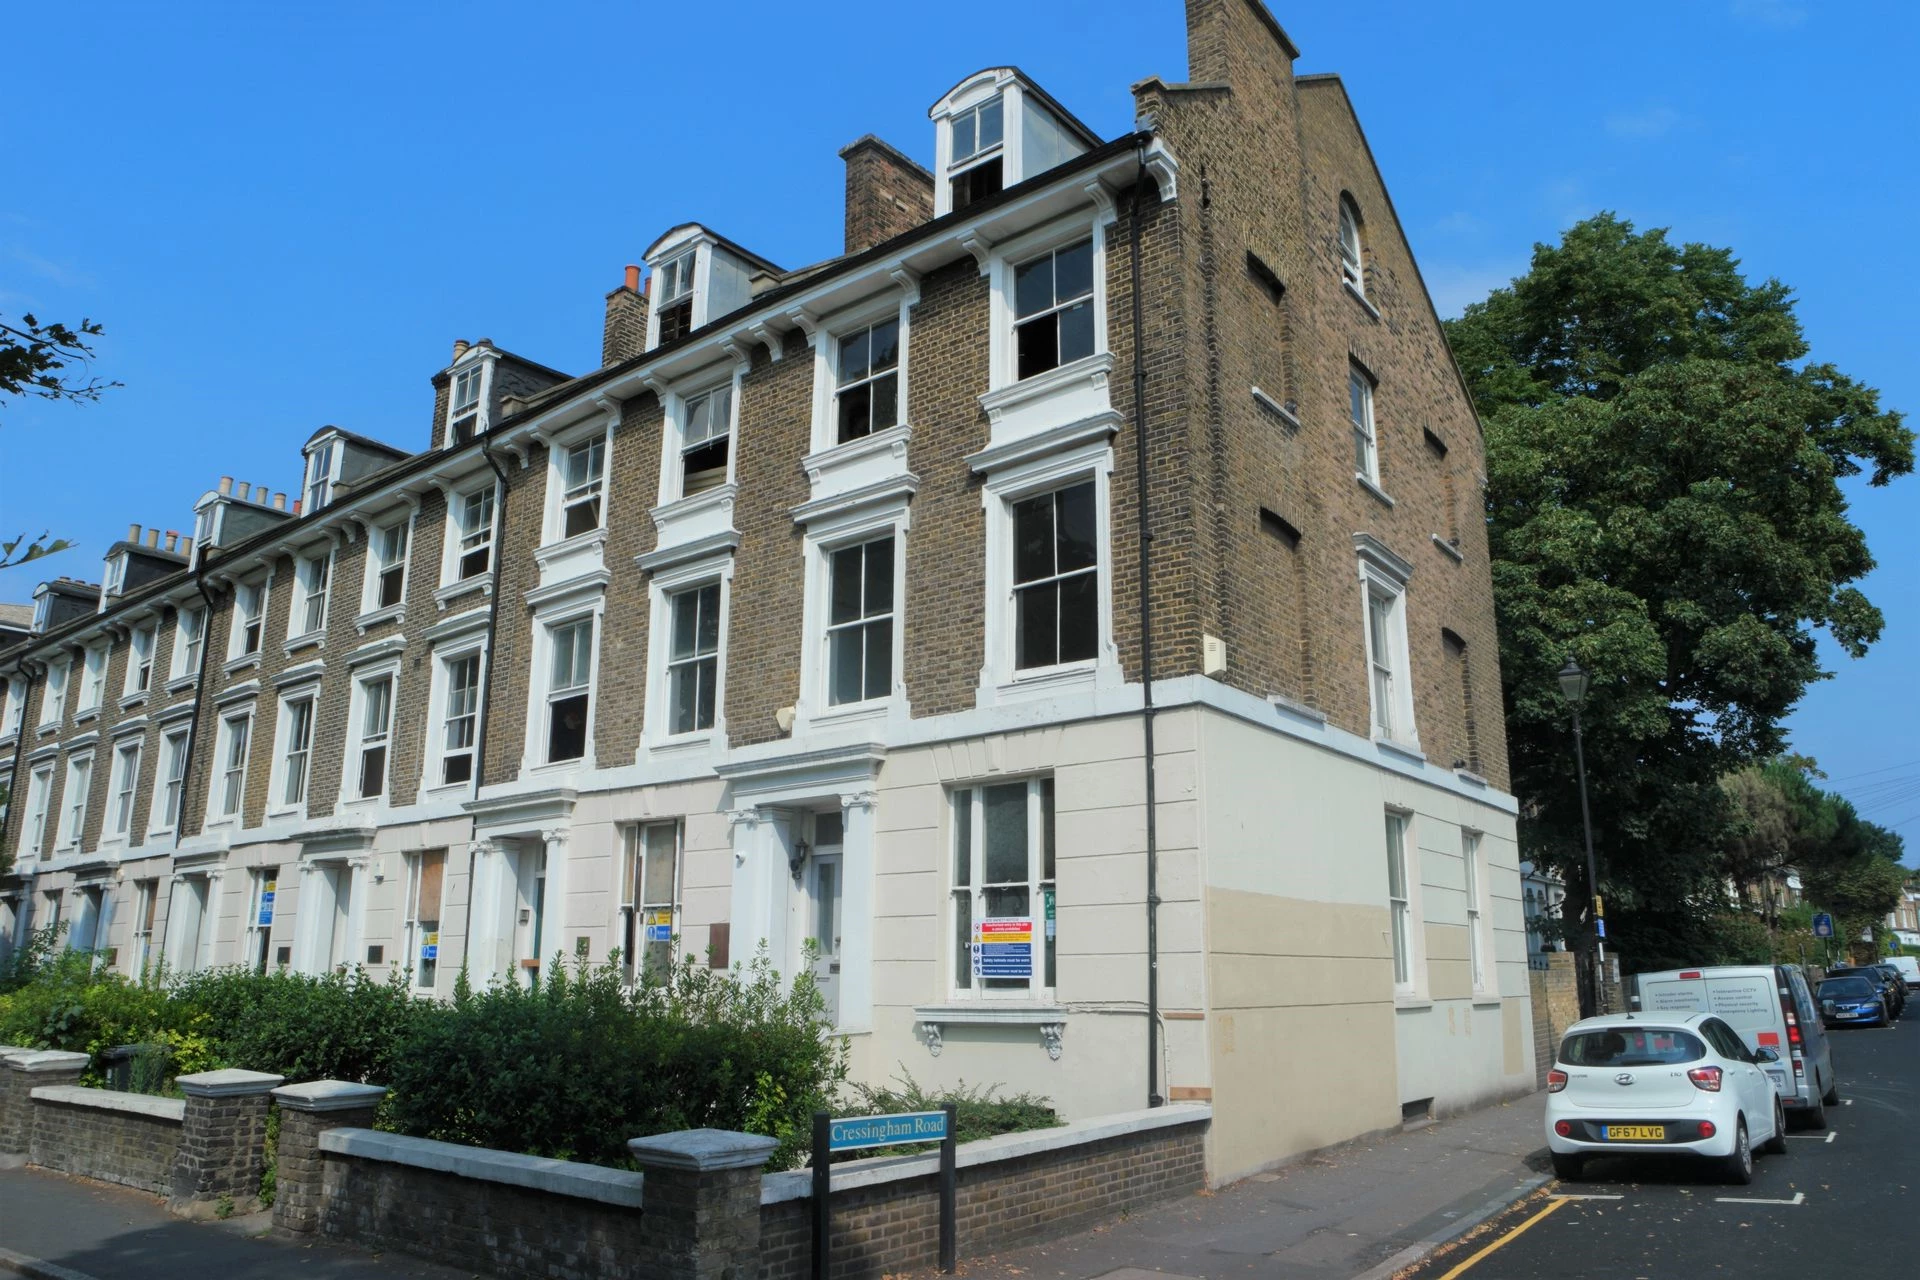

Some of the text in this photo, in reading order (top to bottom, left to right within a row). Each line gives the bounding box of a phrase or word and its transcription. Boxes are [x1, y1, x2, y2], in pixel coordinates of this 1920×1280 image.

[831, 1116, 944, 1142] Cressingham Road
[1609, 1127, 1663, 1138] GF67 LVG
